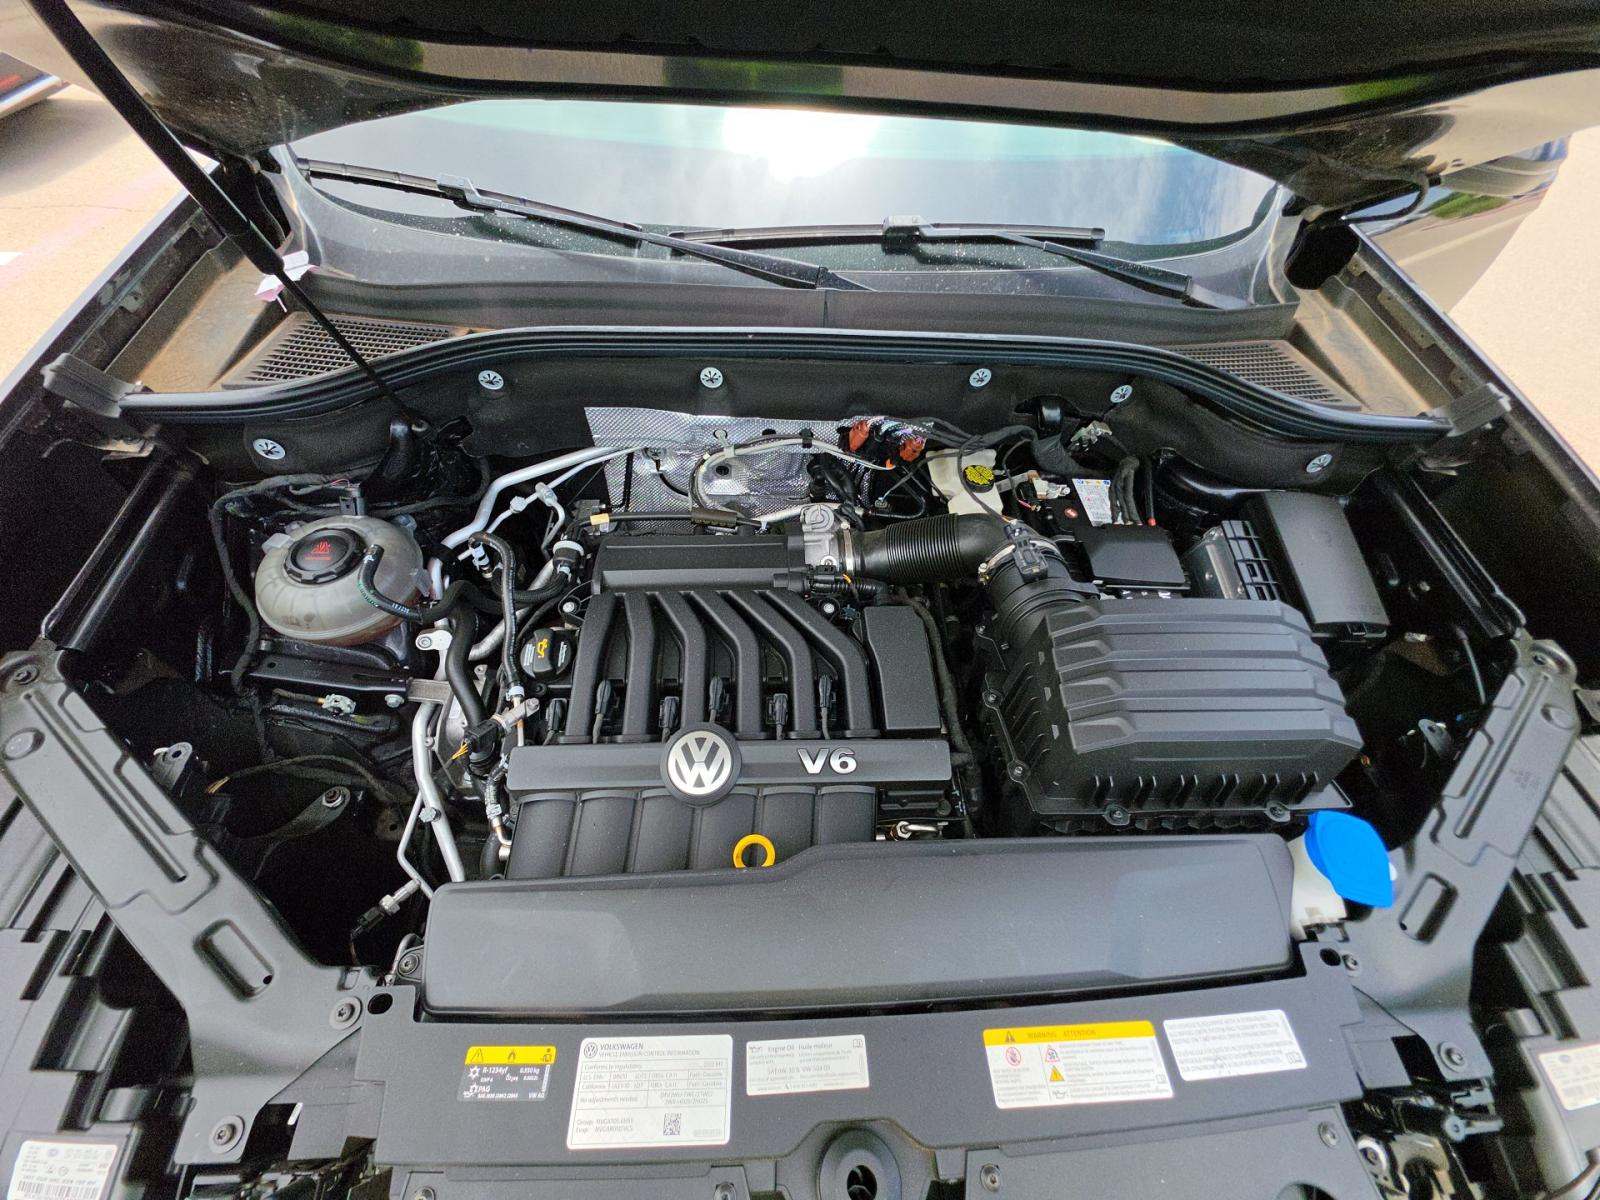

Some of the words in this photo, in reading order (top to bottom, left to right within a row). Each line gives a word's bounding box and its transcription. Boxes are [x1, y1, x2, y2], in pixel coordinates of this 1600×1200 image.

[668, 730, 732, 795] VW
[797, 746, 857, 774] V6
[1027, 1031, 1057, 1039] WARNING
[1063, 1029, 1096, 1037] ATTENTION
[600, 1042, 644, 1050] VOLKSWAGEN
